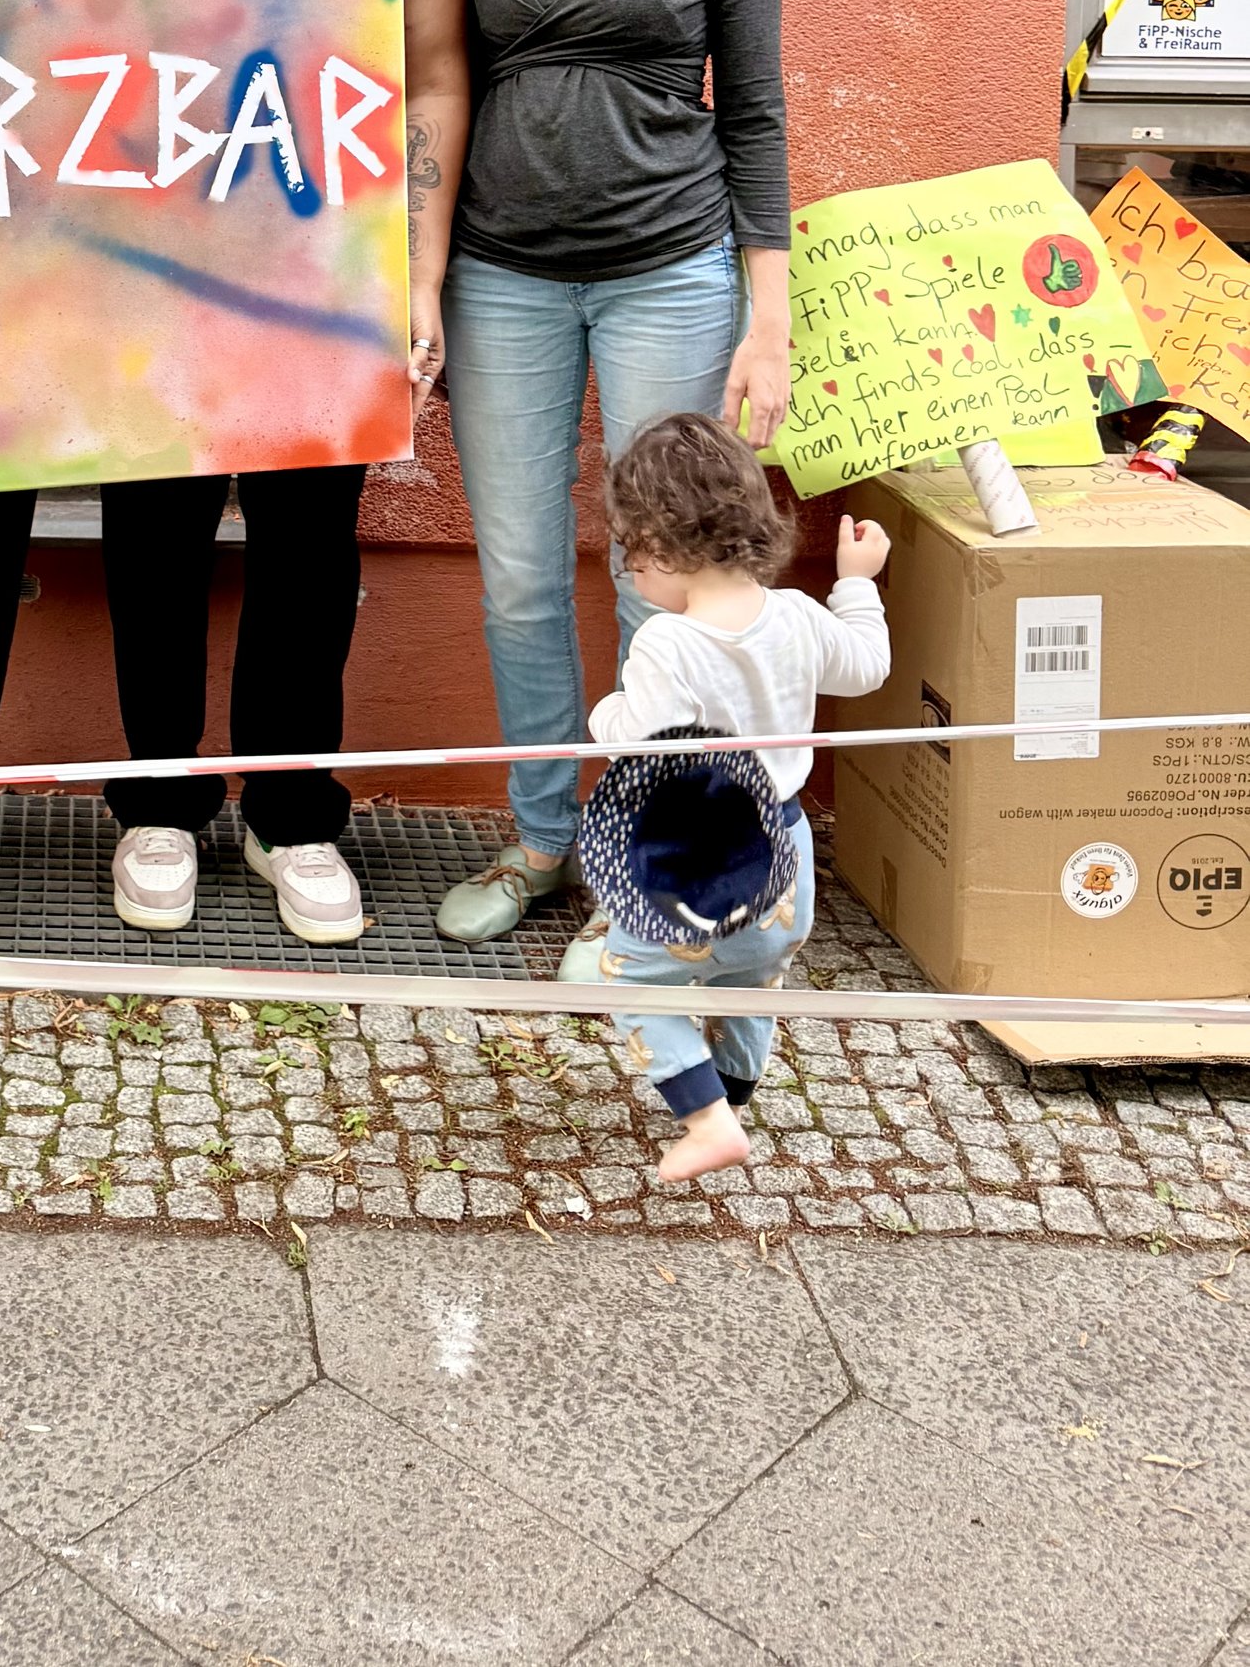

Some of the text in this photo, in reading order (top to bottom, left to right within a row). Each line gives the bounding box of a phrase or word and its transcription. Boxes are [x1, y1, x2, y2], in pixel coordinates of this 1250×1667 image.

[1138, 24, 1222, 38] FiPP-Nische
[1138, 37, 1222, 51] & FreiRaum
[905, 204, 979, 242] dass
[988, 199, 1047, 222] man
[1111, 180, 1167, 254] Ich
[900, 255, 1006, 323] Spiele
[1160, 328, 1223, 359] ich
[1186, 355, 1232, 376] liebe
[852, 359, 941, 425] finds
[1029, 331, 1095, 363] dass
[790, 433, 843, 471] man
[849, 410, 909, 448] hier
[926, 391, 994, 422] einen
[840, 405, 1070, 481] aufbauen kann
[1165, 736, 1195, 749] KGS
[1202, 736, 1223, 749] 8.8
[1165, 772, 1232, 785] 80001270
[1127, 789, 1196, 802] PO602995
[1197, 789, 1220, 801] No.
[999, 806, 1044, 820] wagon
[1046, 807, 1074, 819] with
[1075, 806, 1117, 819] maker
[1119, 805, 1174, 819] Popcorn
[1168, 866, 1243, 892] EPIQ
[1071, 889, 1123, 911] algufix
